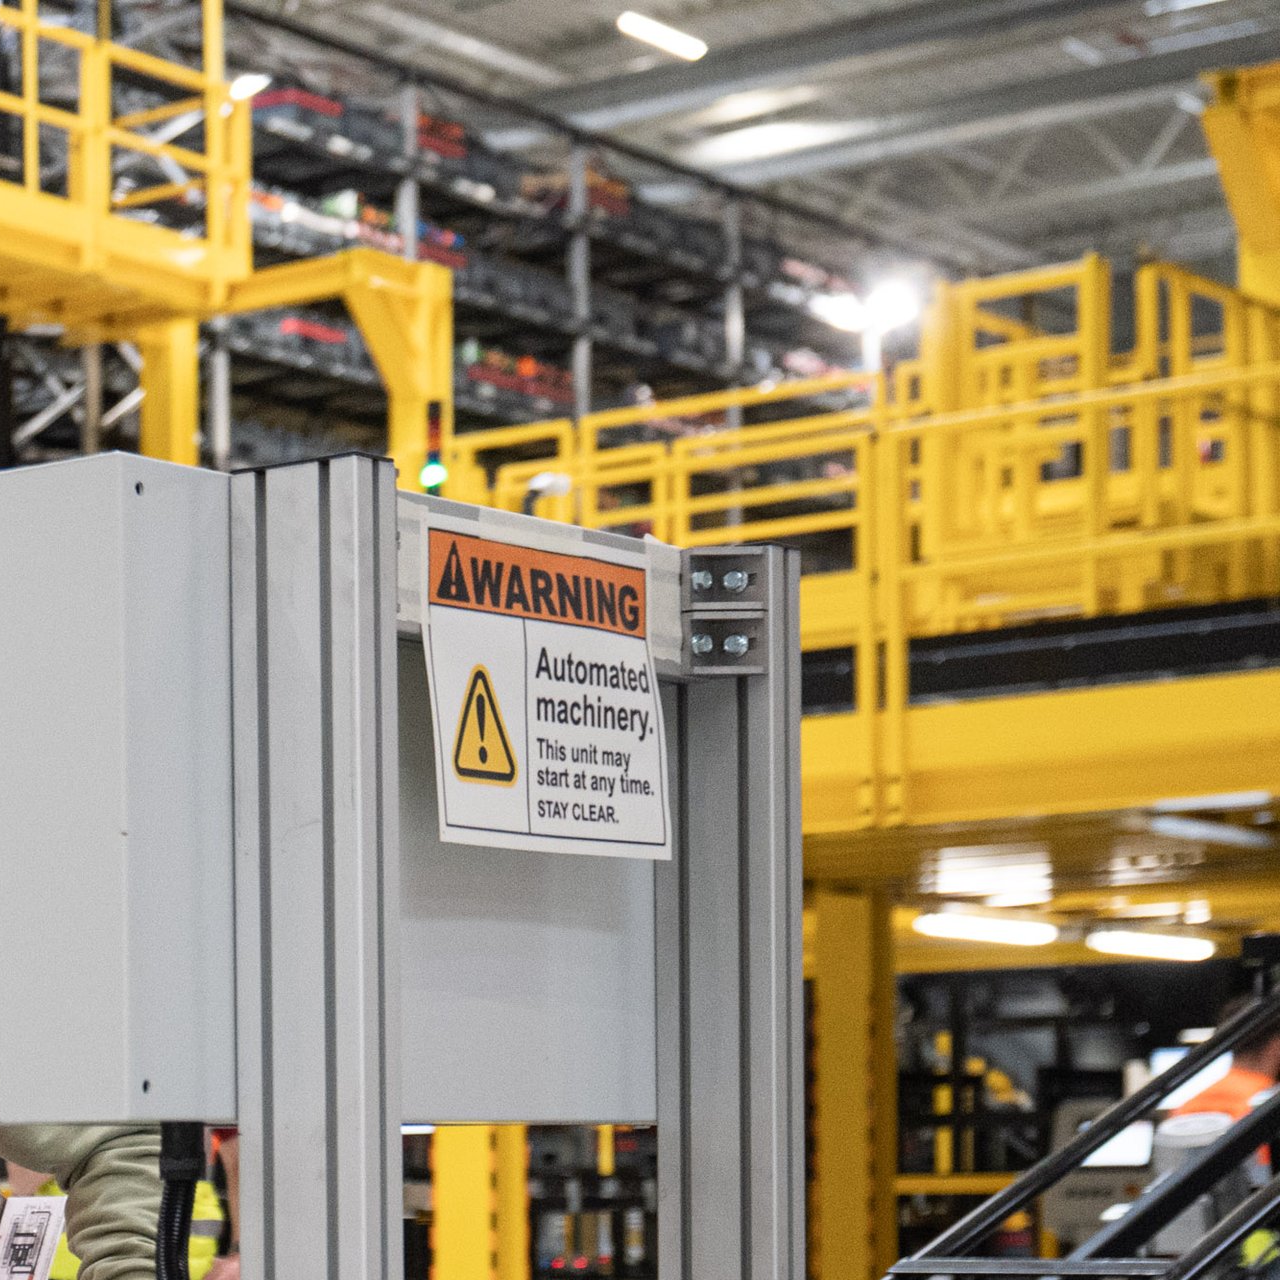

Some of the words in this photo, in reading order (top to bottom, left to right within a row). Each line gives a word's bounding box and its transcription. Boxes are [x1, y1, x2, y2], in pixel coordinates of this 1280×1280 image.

[470, 556, 641, 631] WARNING
[535, 647, 650, 694] Automated
[536, 694, 655, 741] machinery.
[536, 738, 567, 762] This
[571, 743, 598, 767] unit
[601, 750, 631, 772] may
[537, 768, 570, 789] start
[573, 773, 588, 790] at
[590, 776, 616, 798] any
[620, 773, 655, 797] time.
[537, 800, 568, 820] STAY
[572, 804, 620, 824] CLEAR.
